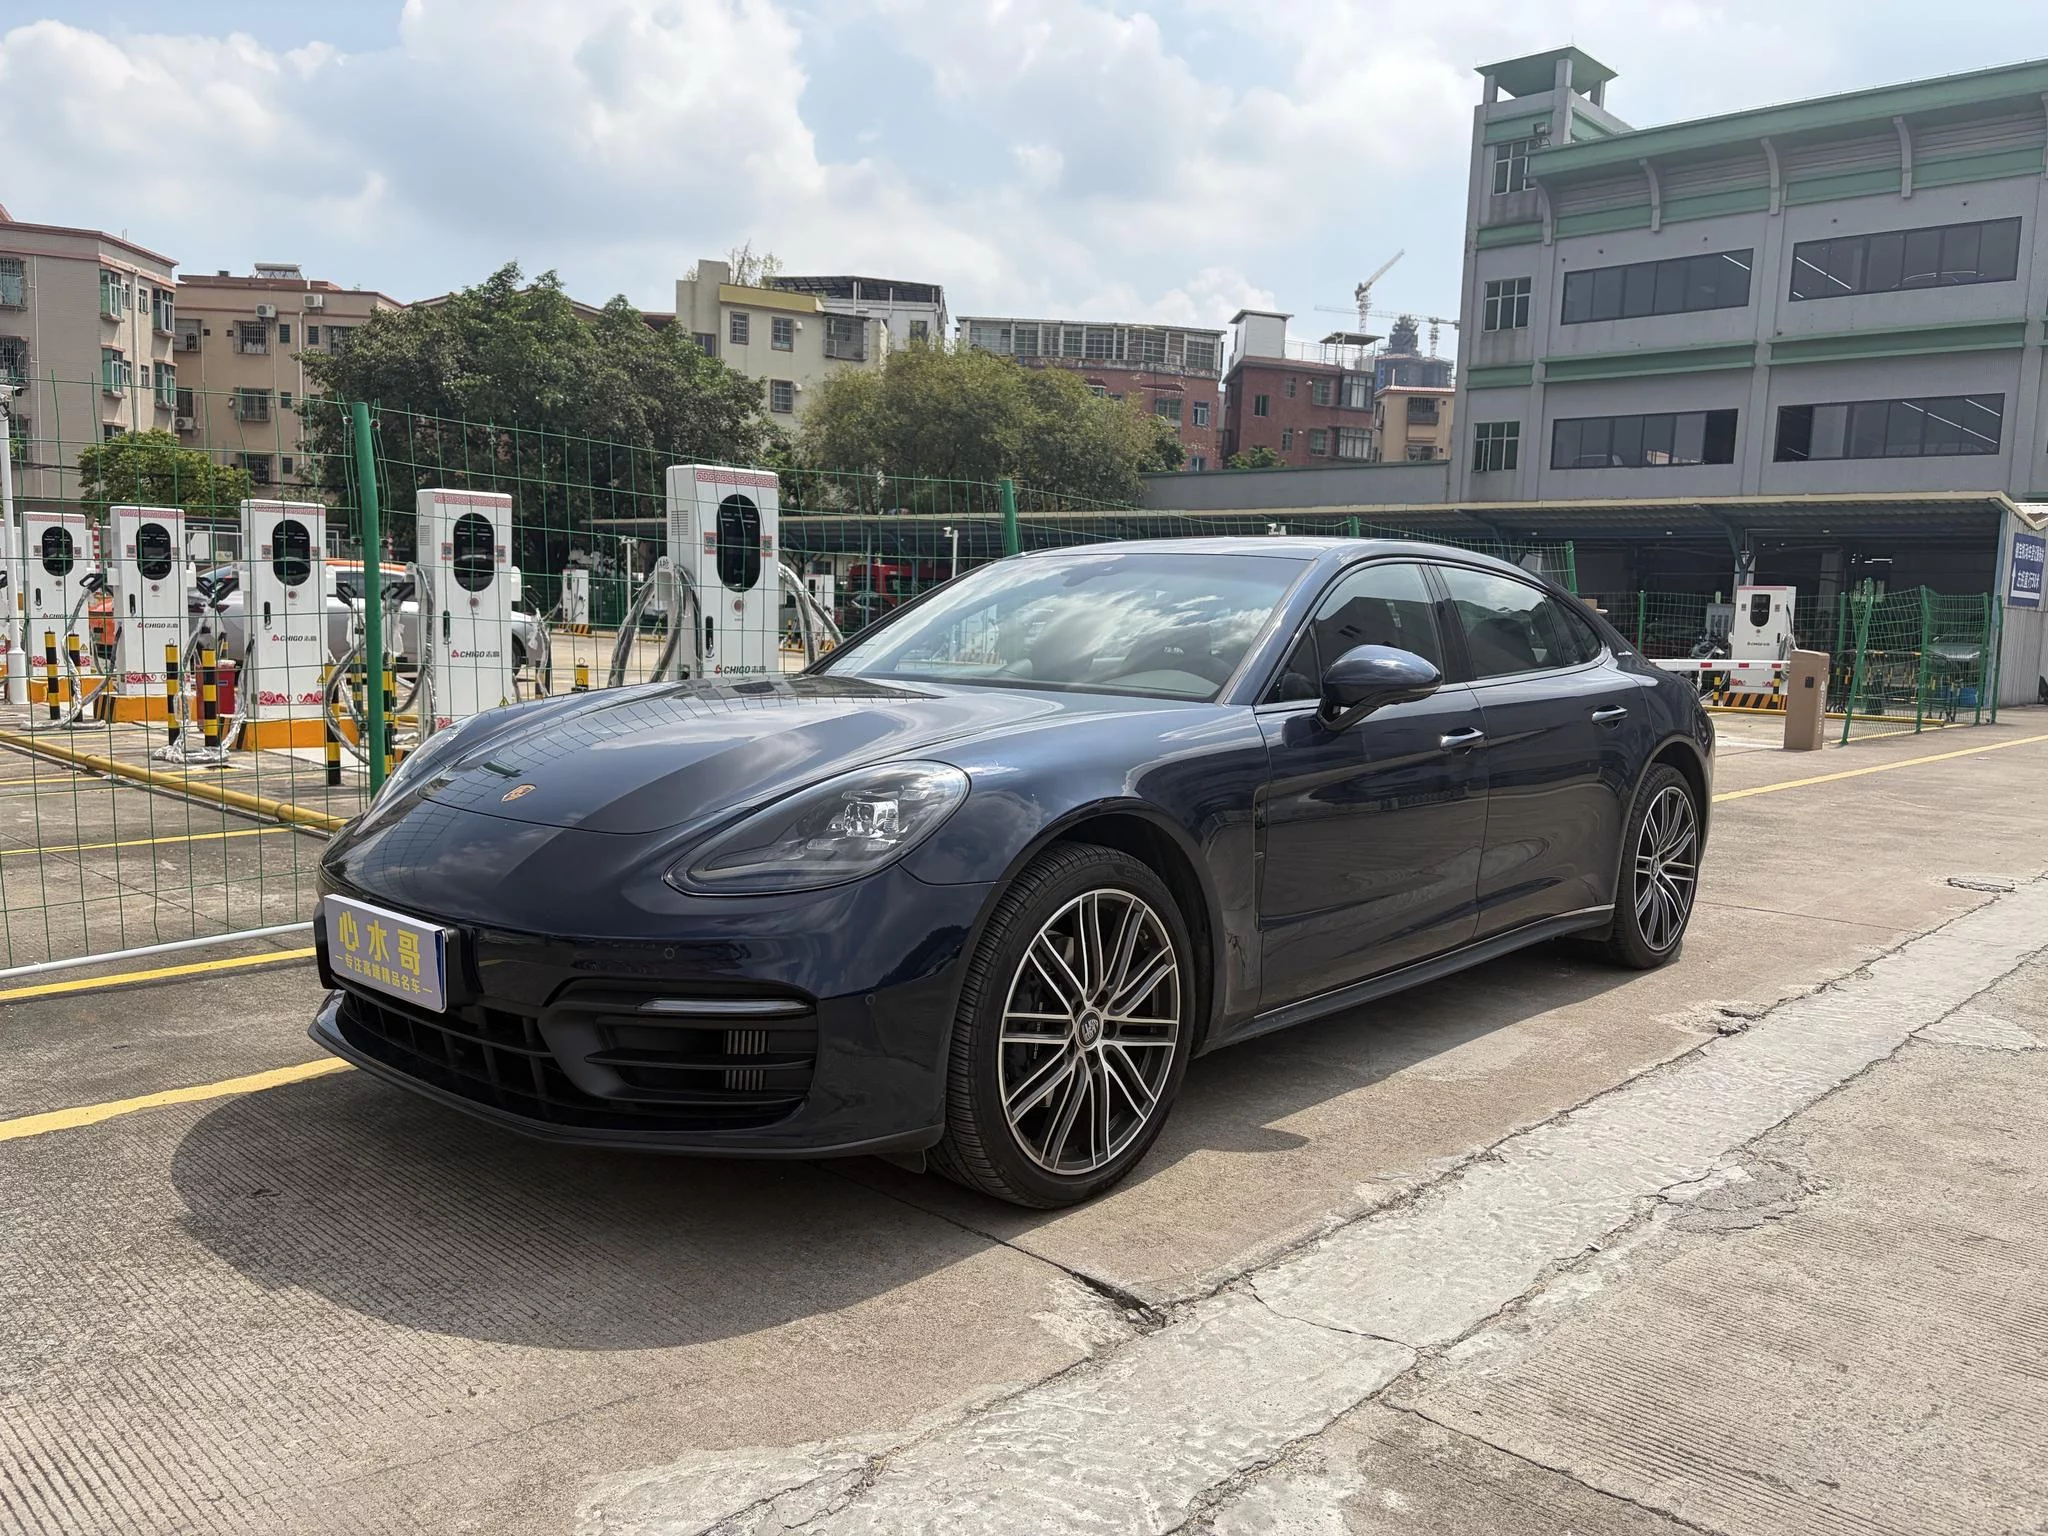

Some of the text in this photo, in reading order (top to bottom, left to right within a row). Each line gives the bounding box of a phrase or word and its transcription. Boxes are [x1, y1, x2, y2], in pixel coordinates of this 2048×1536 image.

[460, 650, 485, 658] CHIGO
[723, 665, 751, 674] CHIGO
[339, 911, 420, 976] 心水哥
